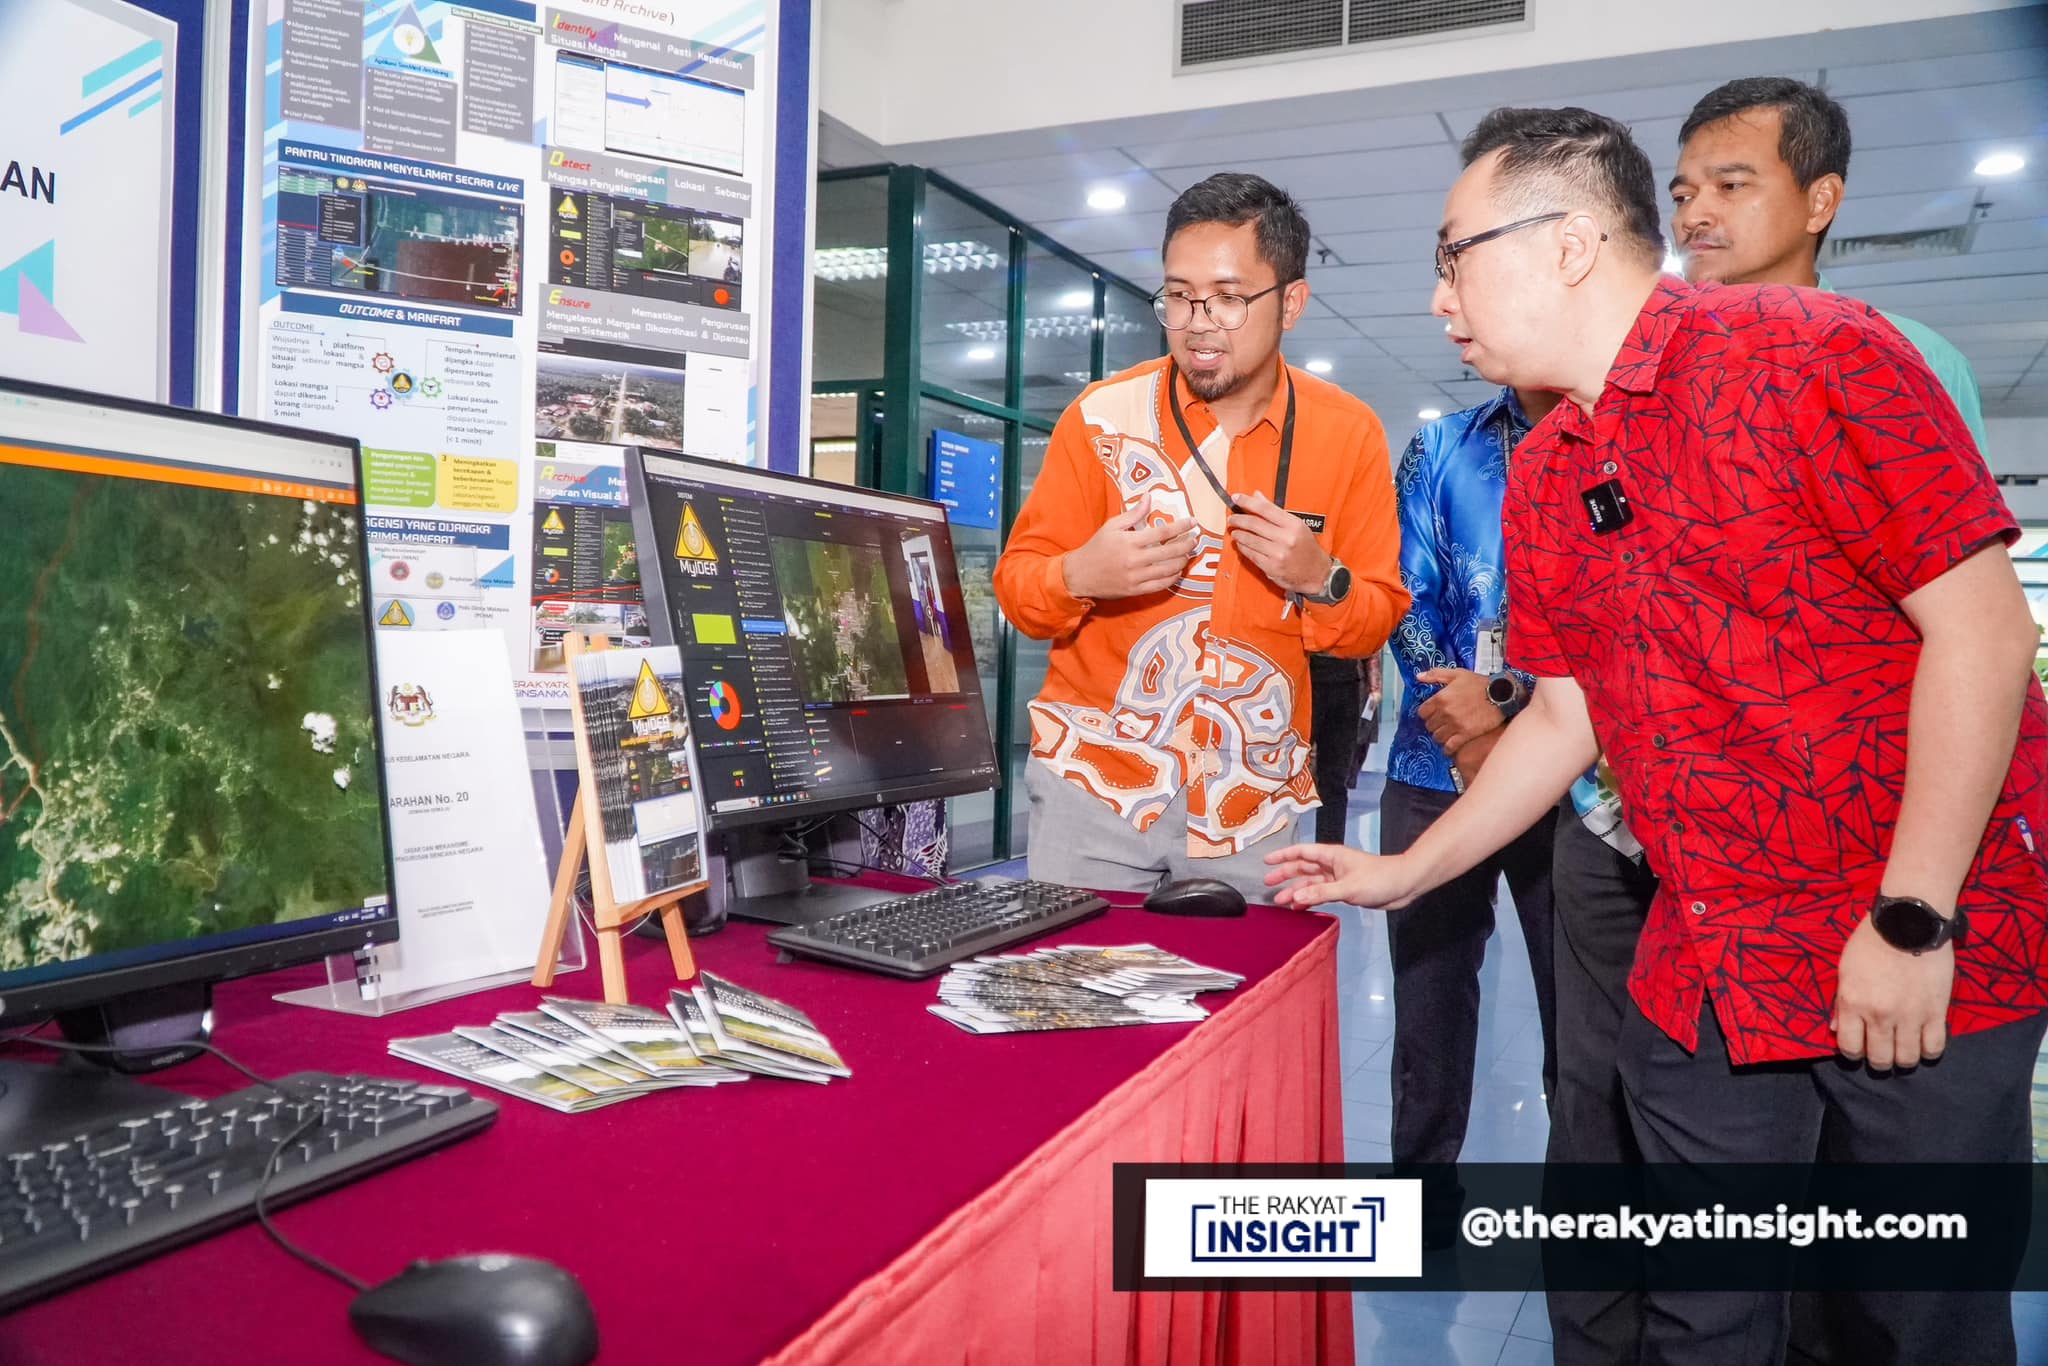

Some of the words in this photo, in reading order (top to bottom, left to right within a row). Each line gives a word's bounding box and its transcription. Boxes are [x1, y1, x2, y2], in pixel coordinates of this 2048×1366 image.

[552, 13, 598, 39] Identify
[551, 34, 586, 50] Situasi
[588, 43, 628, 59] Mangsa
[614, 33, 661, 51] Mengenal
[667, 45, 692, 57] Pasti
[697, 52, 743, 70] Keperluan
[285, 146, 328, 162] PANTAU
[330, 152, 382, 170] TINDAKAN
[383, 161, 453, 182] MENYELAMAT
[455, 174, 495, 190] SECARA
[496, 181, 521, 193] LIVE
[549, 151, 592, 171] Detect
[547, 171, 588, 188] Mangsa
[589, 178, 648, 198] Penyelamat
[615, 168, 665, 186] Mengesan
[675, 179, 705, 193] Lokasi
[714, 185, 751, 201] Sebenar
[549, 289, 592, 309] Ensure
[339, 303, 395, 320] OUTCOME
[395, 306, 405, 320] &
[407, 309, 462, 327] MANFAAT
[631, 307, 684, 323] Memastikan
[700, 317, 749, 333] Pengurusan
[273, 320, 314, 332] OUTCOME
[546, 310, 602, 326] Menyelamat
[606, 318, 641, 332] Mangsa
[645, 323, 698, 338] Dikoordinasi
[702, 330, 709, 340] &
[712, 332, 749, 347] Dipantau
[546, 322, 580, 336] dengan
[582, 326, 630, 340] Sistematik
[323, 349, 345, 358] lokasi
[332, 342, 365, 352] platform
[474, 350, 516, 361] menyelamat
[272, 353, 296, 362] situasi
[336, 361, 365, 370] mangsa
[274, 379, 298, 388] Lokasi
[299, 383, 329, 392] mangsa
[274, 399, 300, 409] kurang
[297, 392, 327, 400] dikesan
[447, 393, 469, 402] Lokasi
[280, 410, 301, 418] minit
[541, 465, 587, 483] Archive
[538, 486, 579, 499] Paparan
[581, 489, 612, 501] Visual
[614, 492, 621, 501] &
[405, 520, 436, 531] YANG
[438, 523, 491, 535] DIJANGKA
[402, 533, 456, 545] MANFAAT
[680, 560, 718, 577] MyIDEA
[396, 752, 440, 763] KESELAMATAN
[442, 751, 470, 760] NEGARA
[389, 795, 432, 808] ARAHAN
[435, 793, 454, 804] No.
[456, 791, 469, 801] 20
